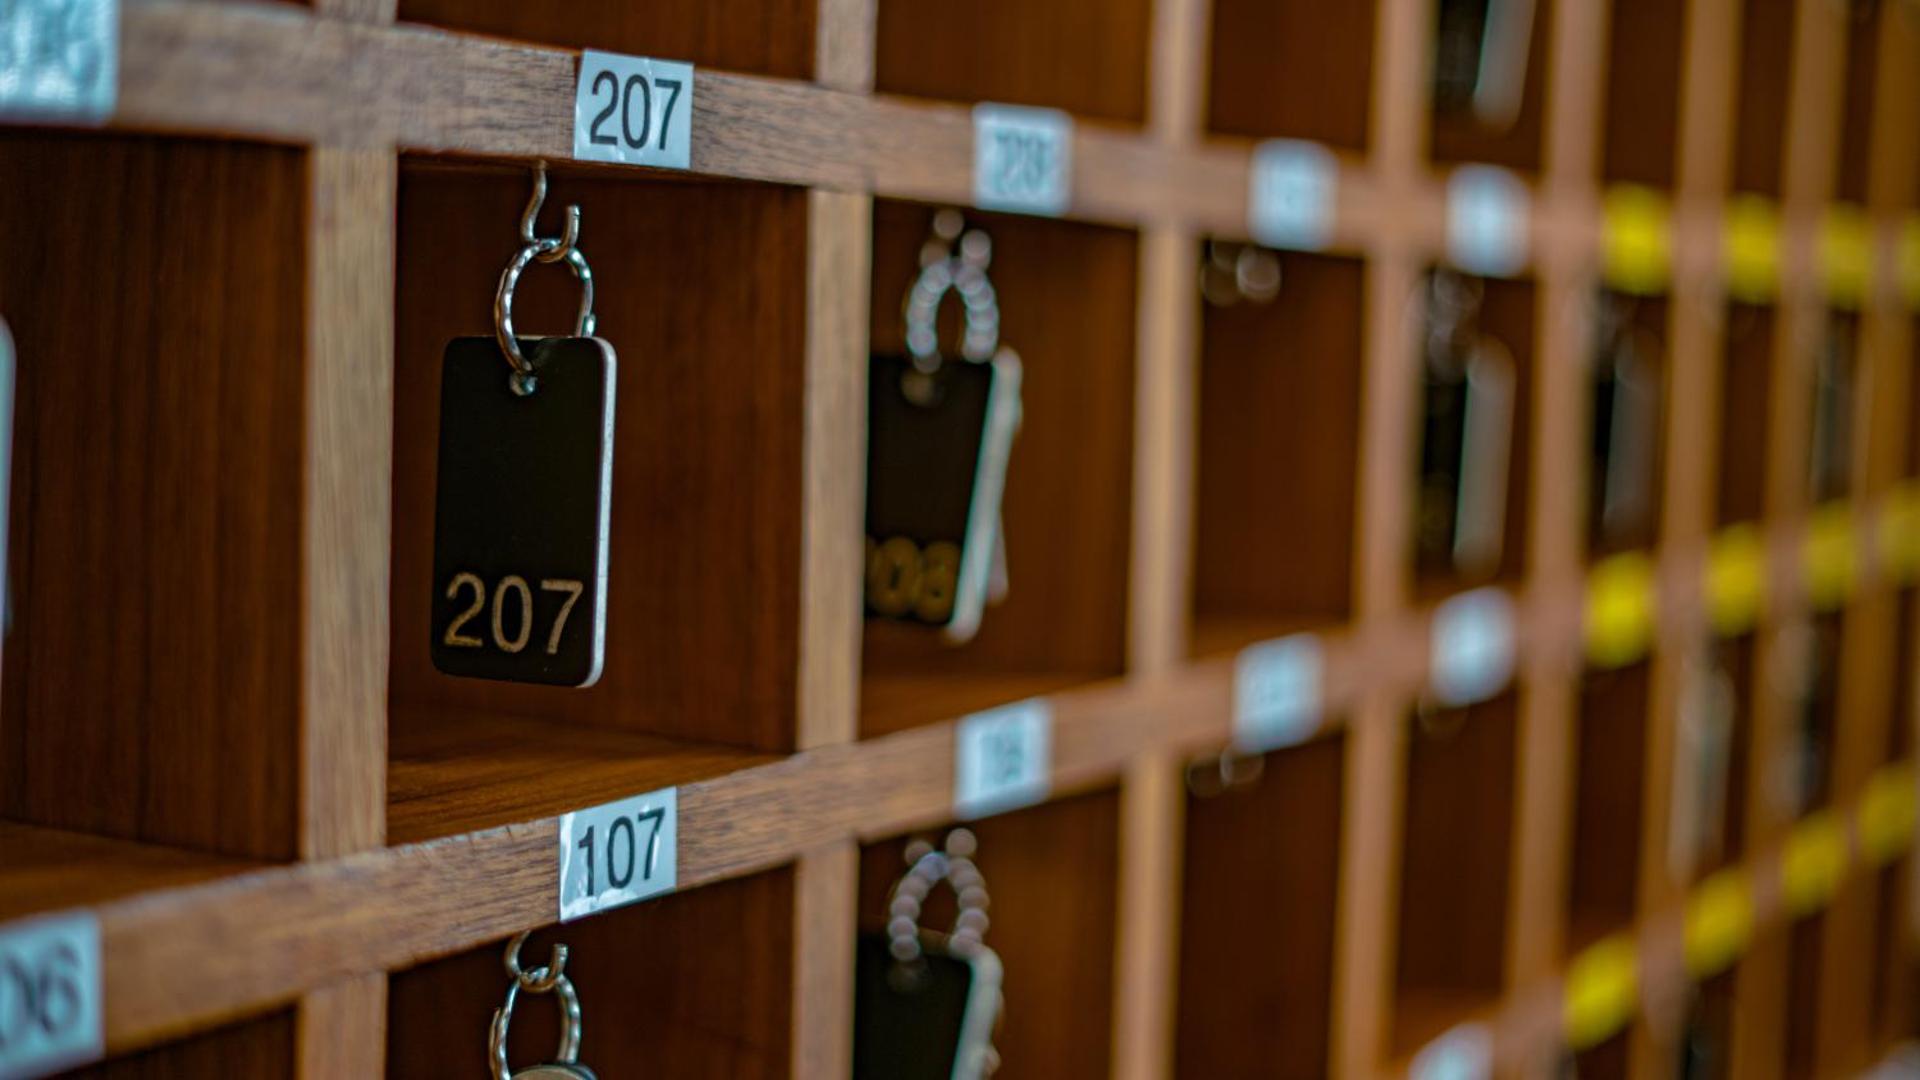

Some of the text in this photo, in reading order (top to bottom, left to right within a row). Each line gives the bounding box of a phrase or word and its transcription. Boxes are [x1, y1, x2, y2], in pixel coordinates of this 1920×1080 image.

[590, 69, 683, 151] 207
[444, 572, 584, 655] 207
[578, 807, 665, 897] 107
